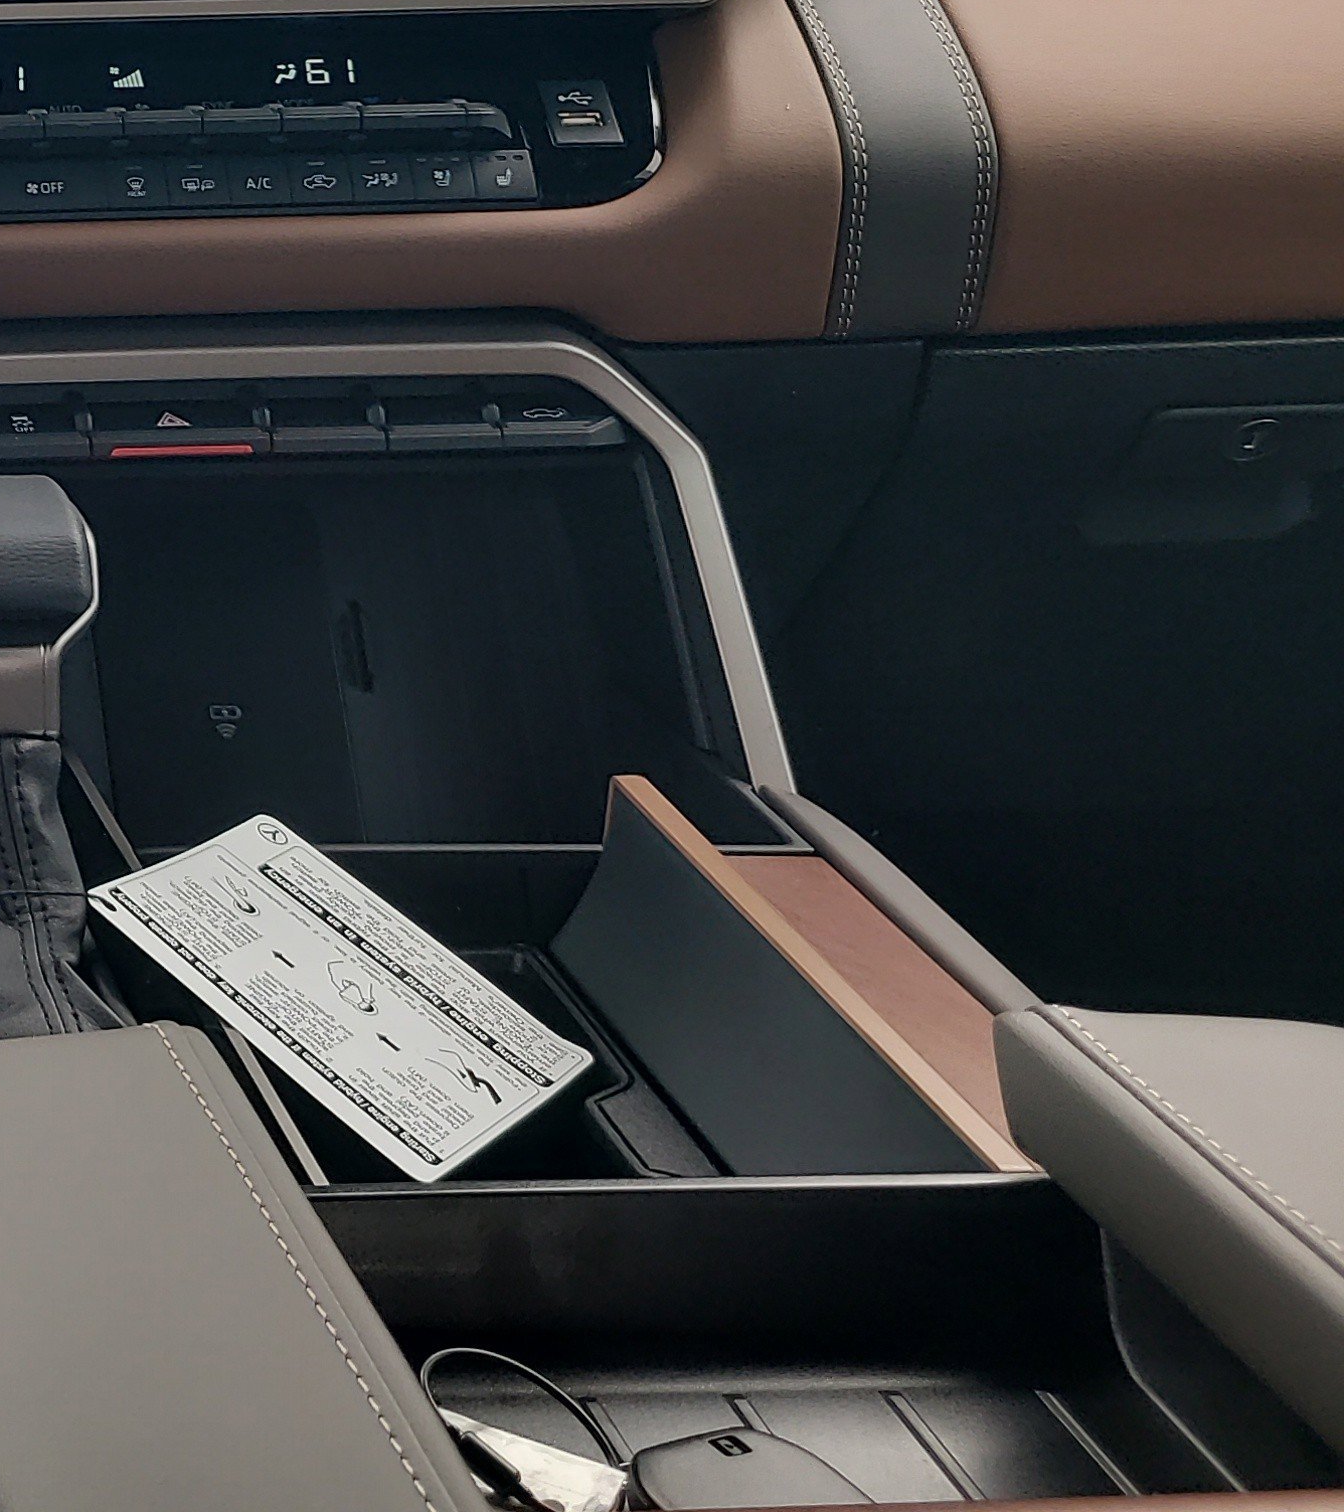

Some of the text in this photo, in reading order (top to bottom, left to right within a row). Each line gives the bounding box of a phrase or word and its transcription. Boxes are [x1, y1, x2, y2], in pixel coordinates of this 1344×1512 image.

[306, 59, 356, 84] 61
[40, 182, 64, 193] OFF
[246, 176, 272, 189] A/C
[262, 866, 327, 913] emergency
[324, 915, 343, 928] an
[341, 928, 357, 940] in
[357, 940, 404, 974] system
[215, 979, 236, 995] key
[401, 974, 444, 1005] hybrid
[231, 994, 278, 1030] electronic
[446, 1008, 491, 1041] engine
[273, 1029, 293, 1044] the
[300, 1049, 337, 1079] system
[490, 1041, 548, 1085] Stopping
[397, 1130, 438, 1163] Starting
